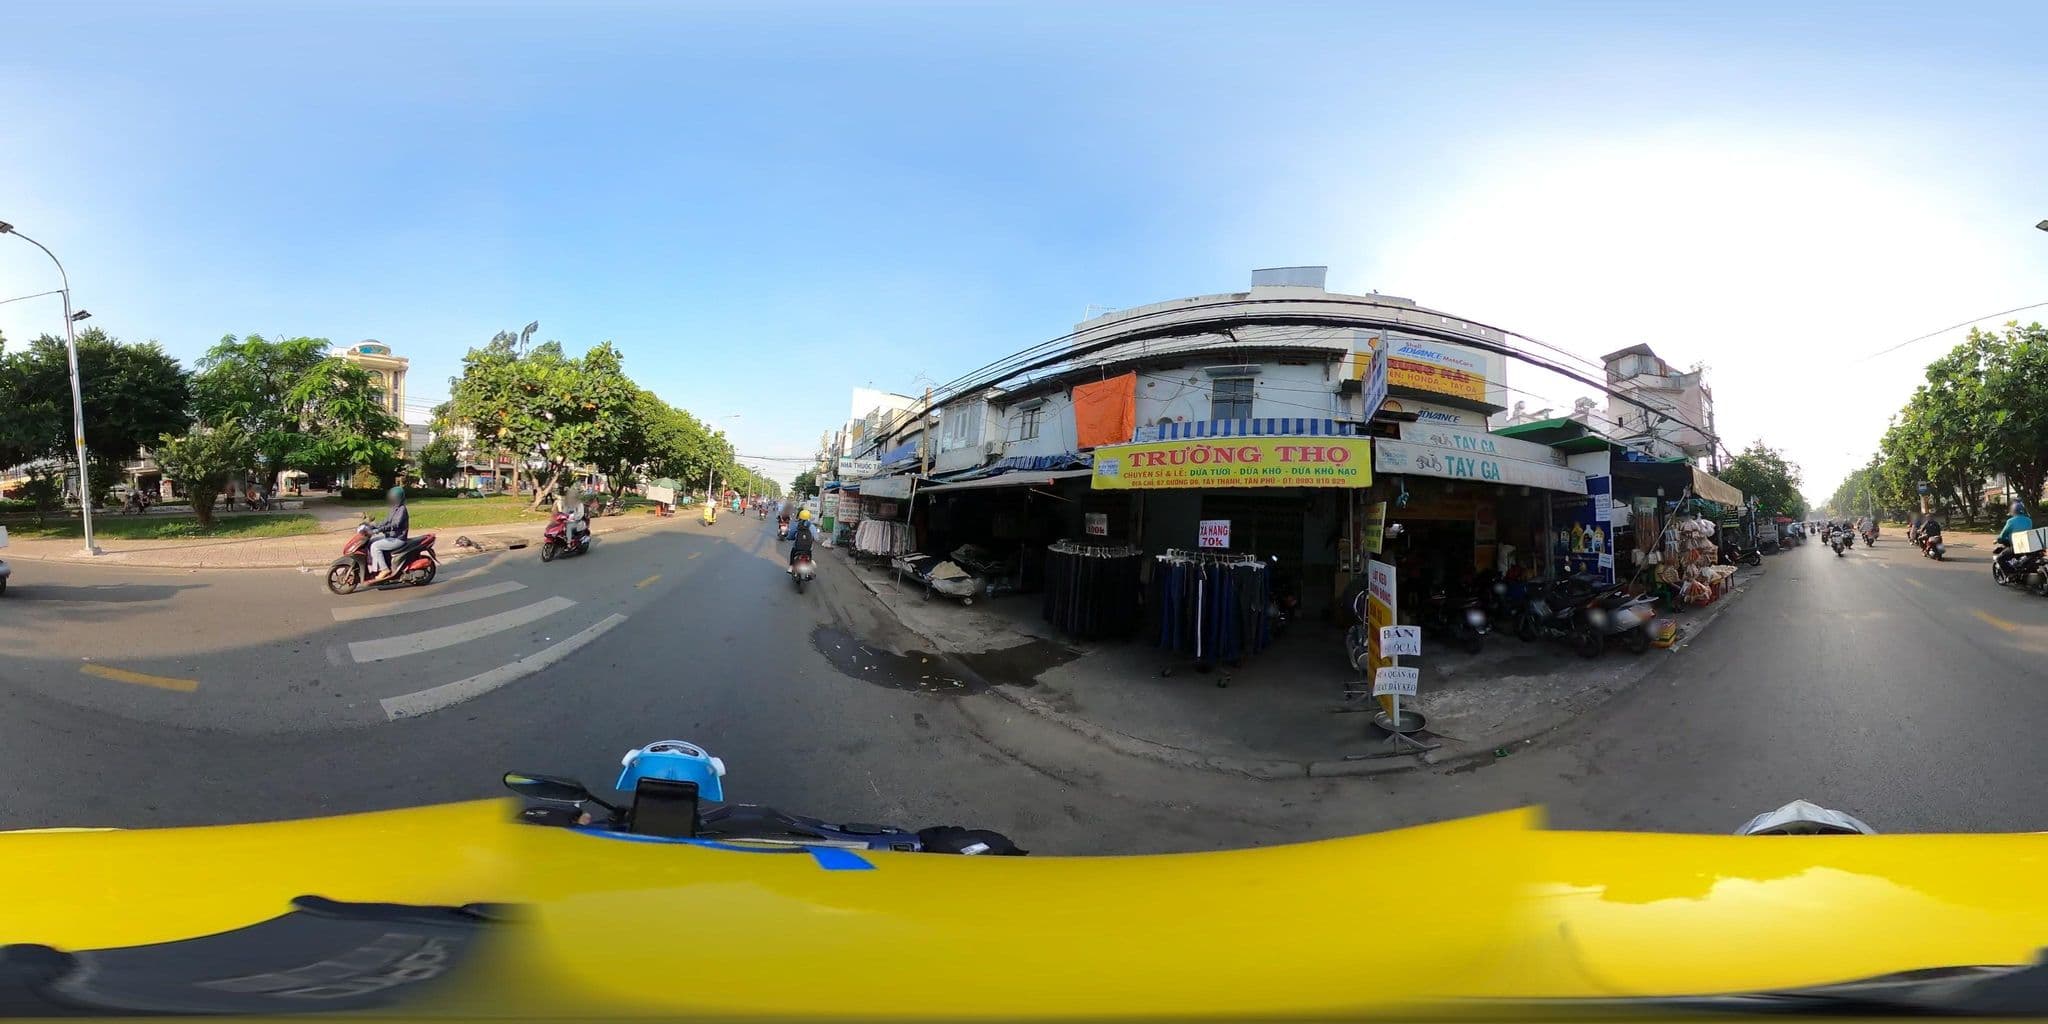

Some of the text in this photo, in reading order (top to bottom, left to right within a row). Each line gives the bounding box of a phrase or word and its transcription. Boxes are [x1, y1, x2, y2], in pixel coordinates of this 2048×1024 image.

[1398, 346, 1442, 360] ADVANCE
[1408, 374, 1440, 385] HONDA
[1418, 410, 1461, 423] ADVANCE
[1453, 434, 1497, 454] TAY GA
[1128, 444, 1351, 467] TRƯỜNG THỌ
[1445, 455, 1501, 481] TAY GA
